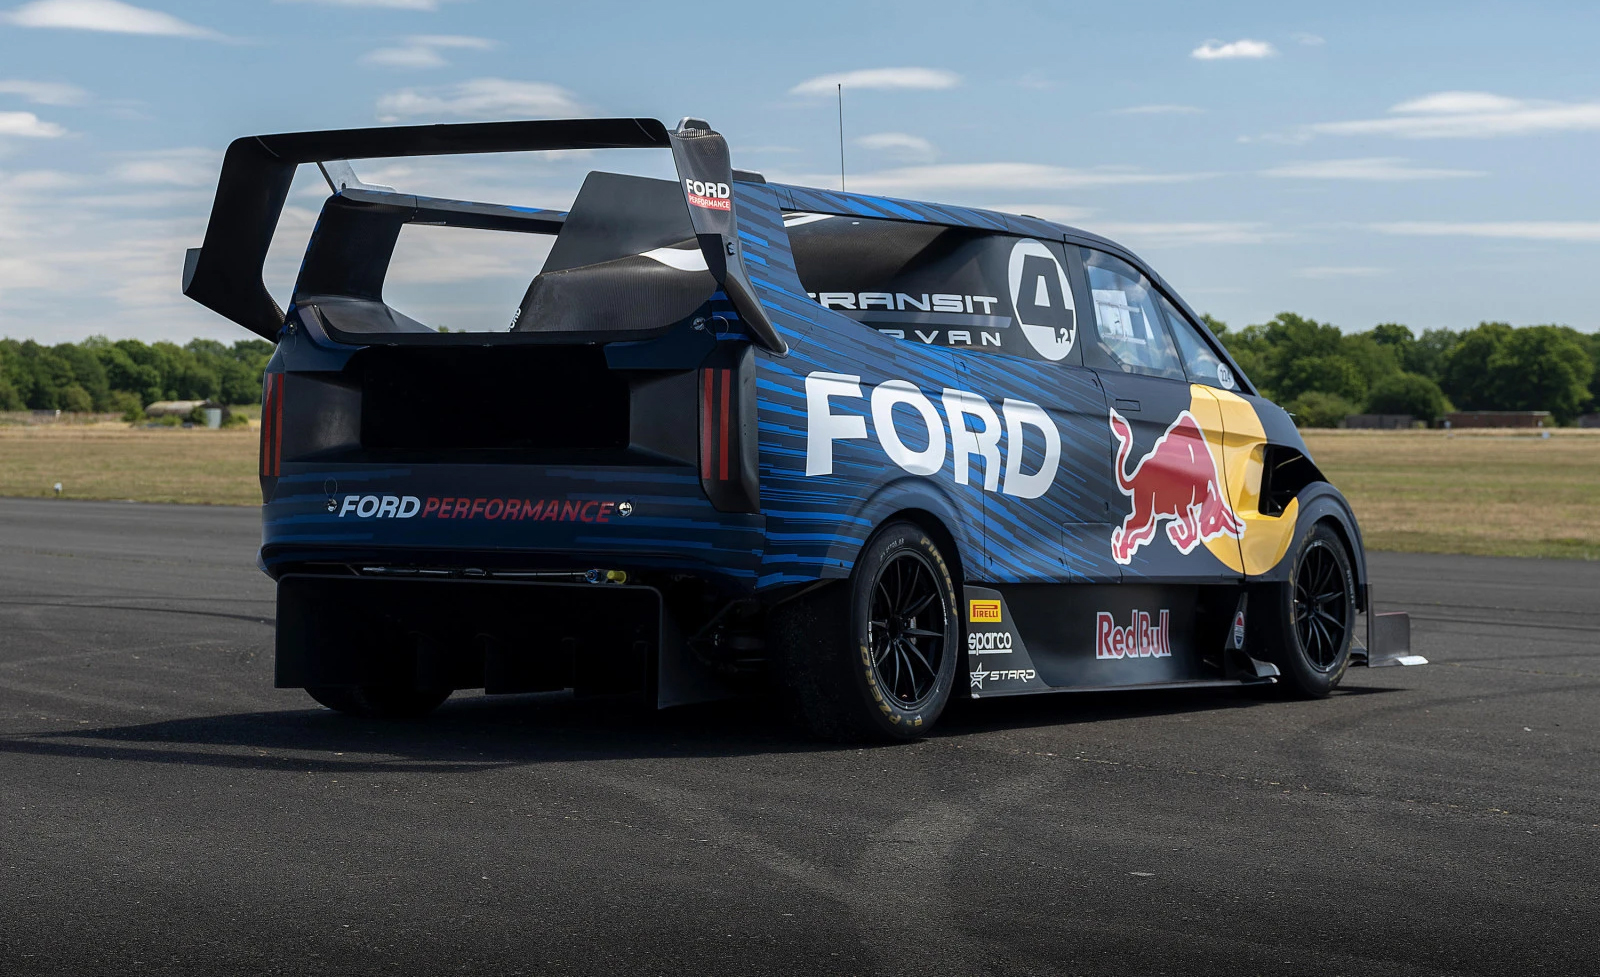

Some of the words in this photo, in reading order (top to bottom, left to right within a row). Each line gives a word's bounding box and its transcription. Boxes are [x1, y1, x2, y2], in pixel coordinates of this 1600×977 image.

[686, 179, 730, 199] FORD
[688, 194, 731, 209] PERFORMANCE
[805, 371, 1062, 500] FORD
[338, 495, 421, 519] FORD
[421, 497, 615, 523] PERFORMANCE
[972, 603, 999, 618] PIRELLI
[968, 631, 1012, 655] sparco
[989, 669, 1036, 682] STARD
